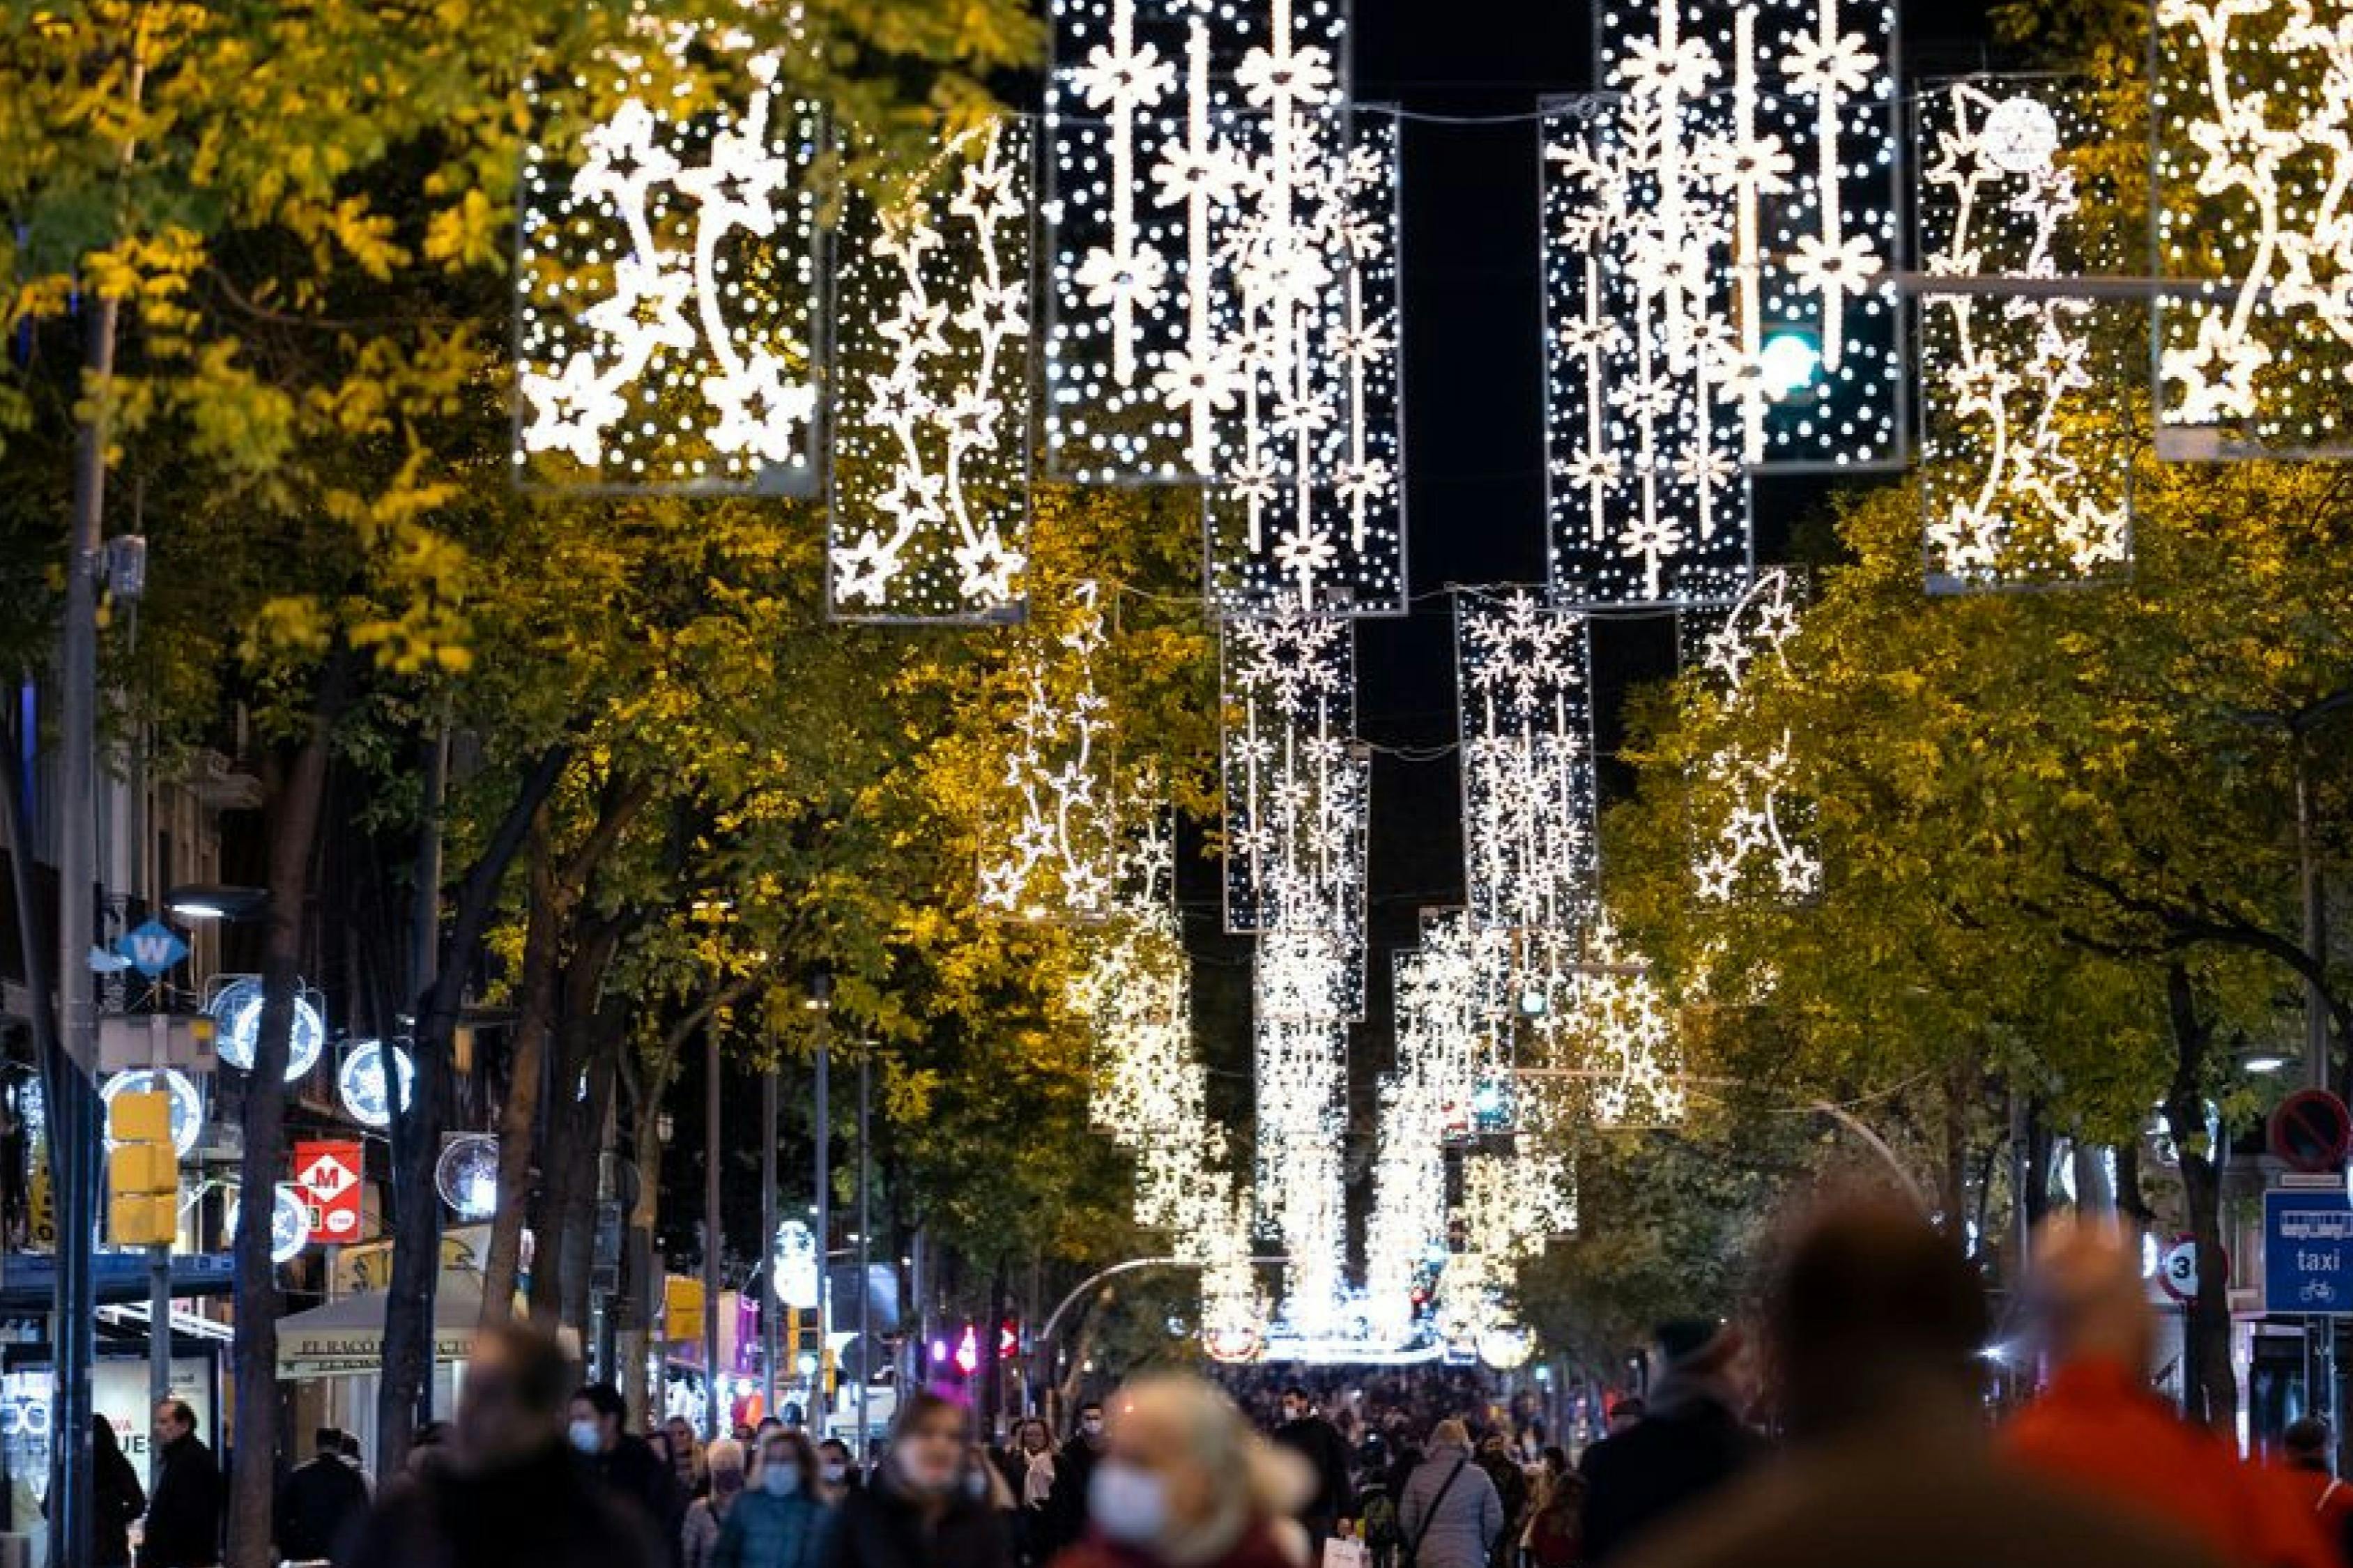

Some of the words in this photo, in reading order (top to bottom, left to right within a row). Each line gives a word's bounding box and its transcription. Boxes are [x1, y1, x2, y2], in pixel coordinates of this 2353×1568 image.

[132, 935, 171, 964] W
[315, 1166, 339, 1189] M
[2172, 1256, 2191, 1279] 3
[2297, 1248, 2340, 1271] taxi
